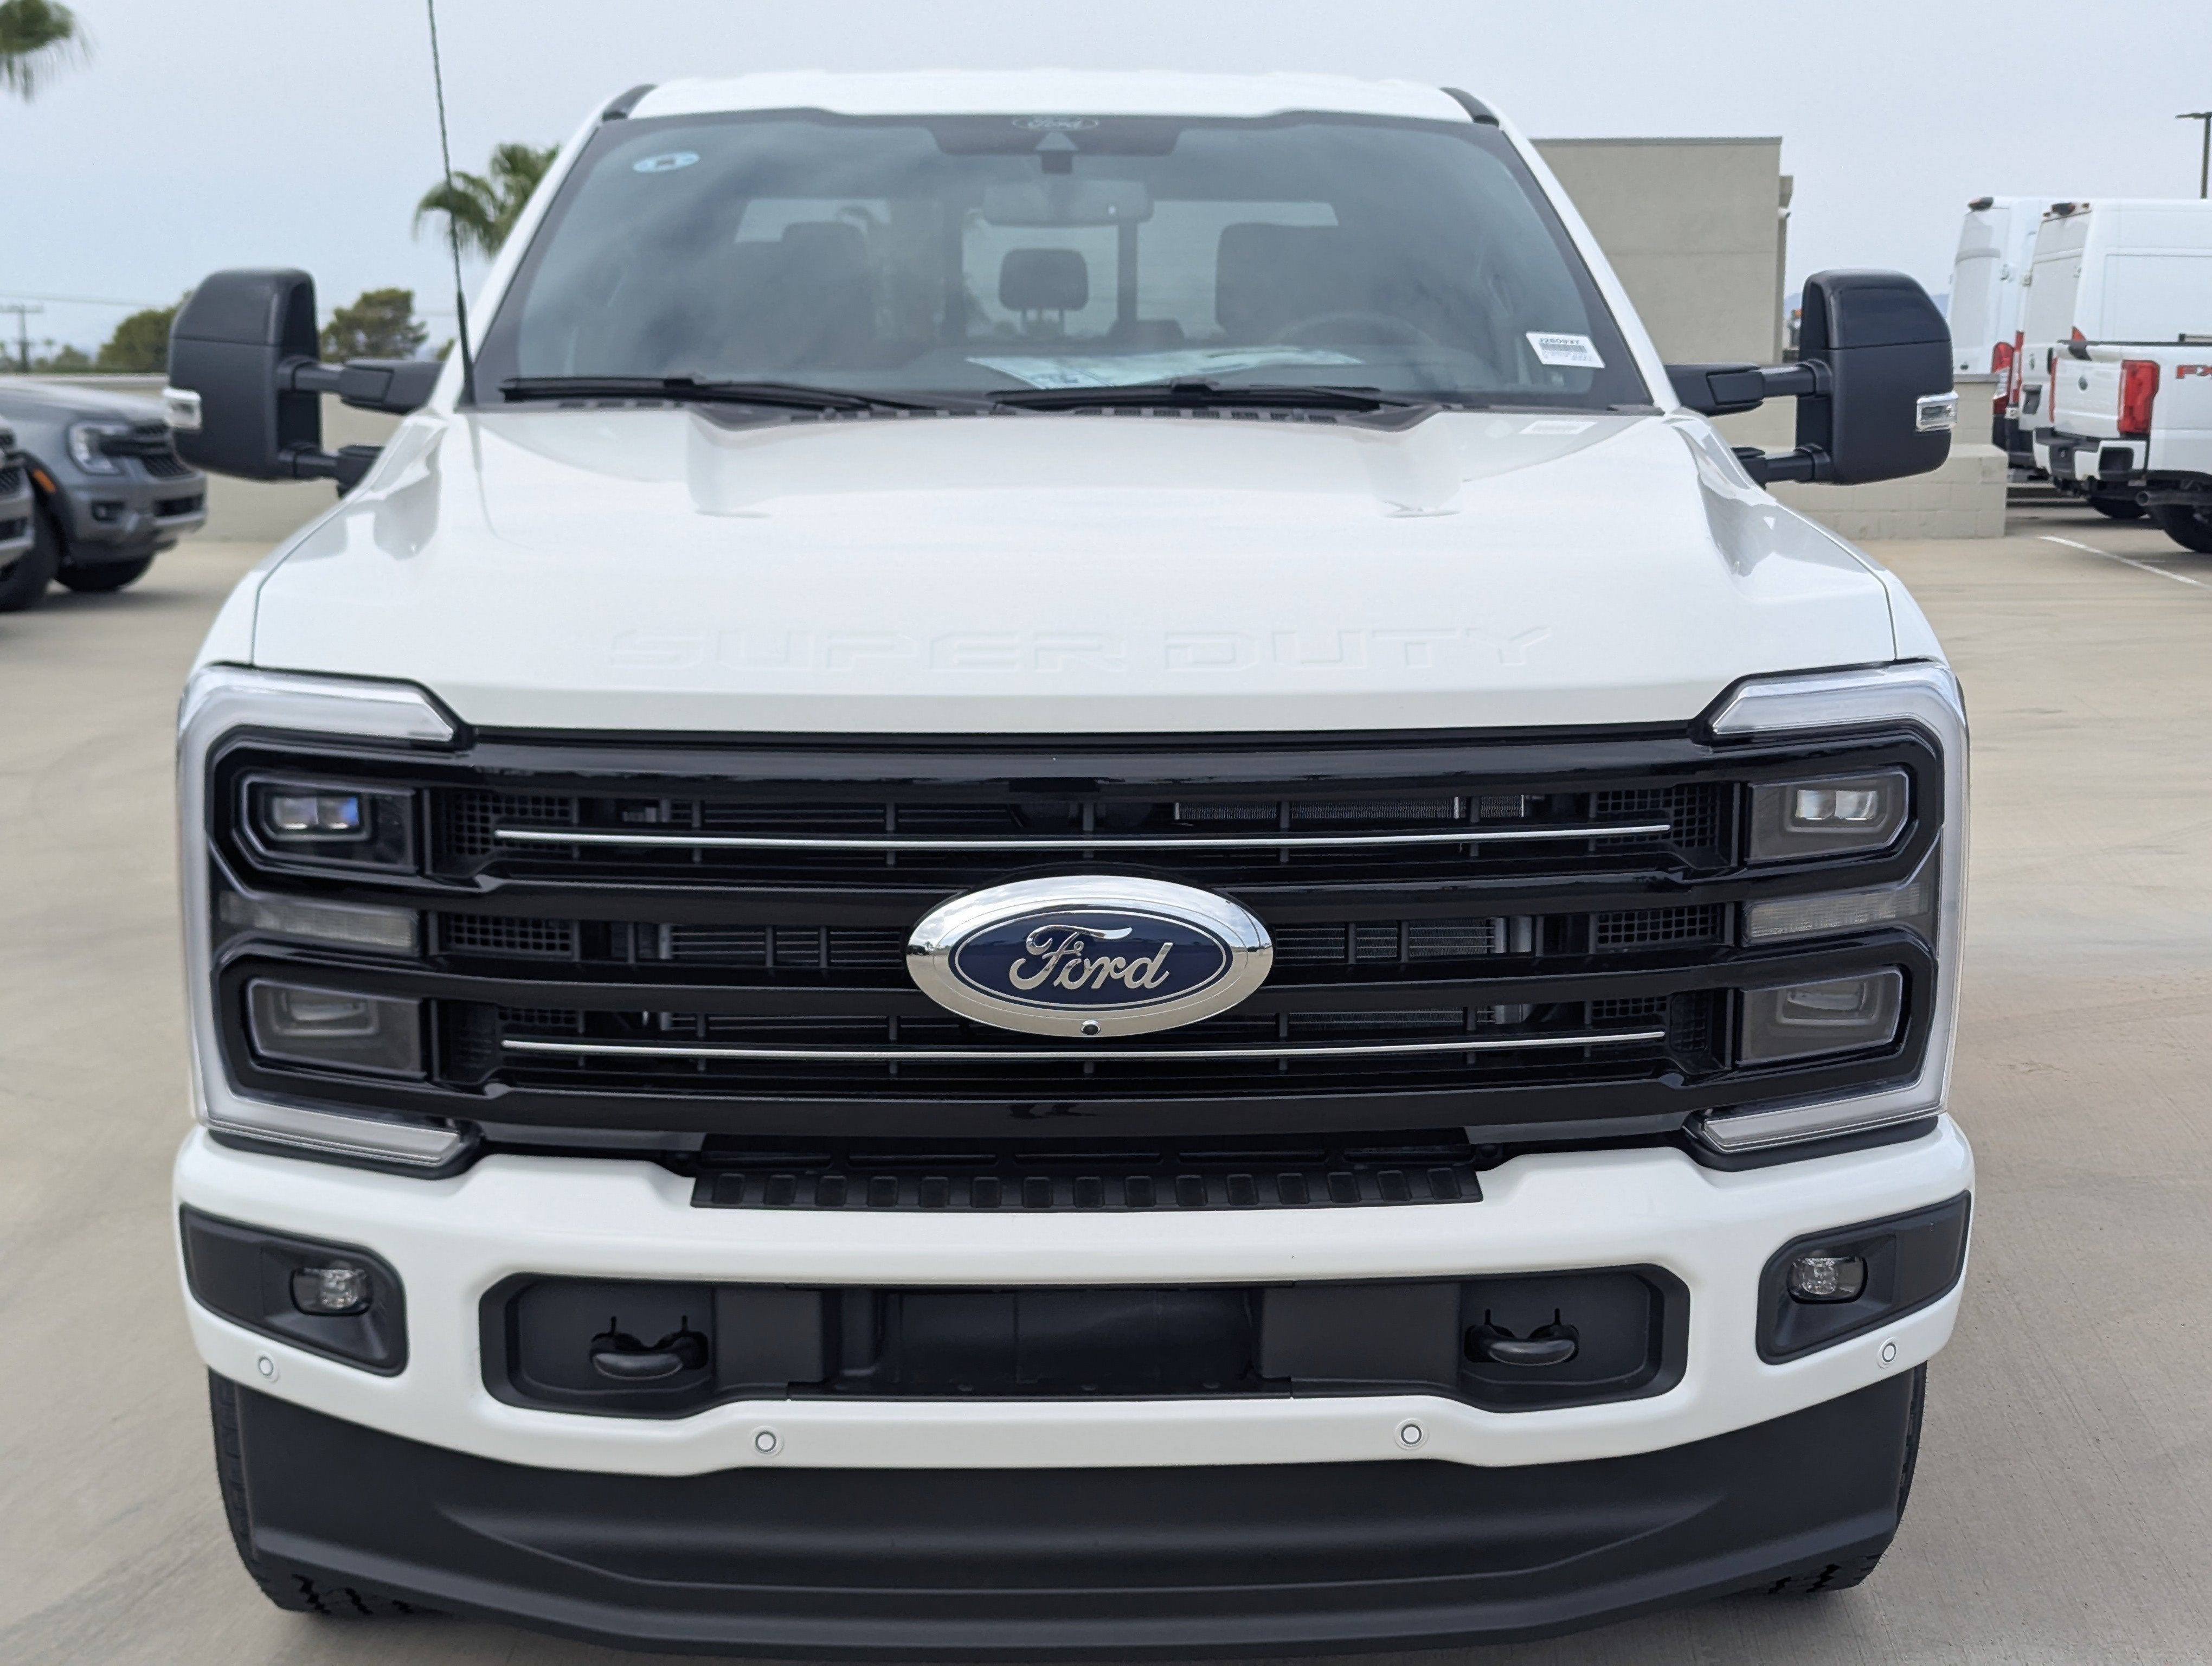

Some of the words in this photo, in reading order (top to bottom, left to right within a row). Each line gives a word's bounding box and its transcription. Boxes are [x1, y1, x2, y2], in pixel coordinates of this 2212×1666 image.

[609, 628, 1128, 673] SUPER
[1163, 625, 1554, 672] DUTY
[1009, 924, 1173, 990] Ford
